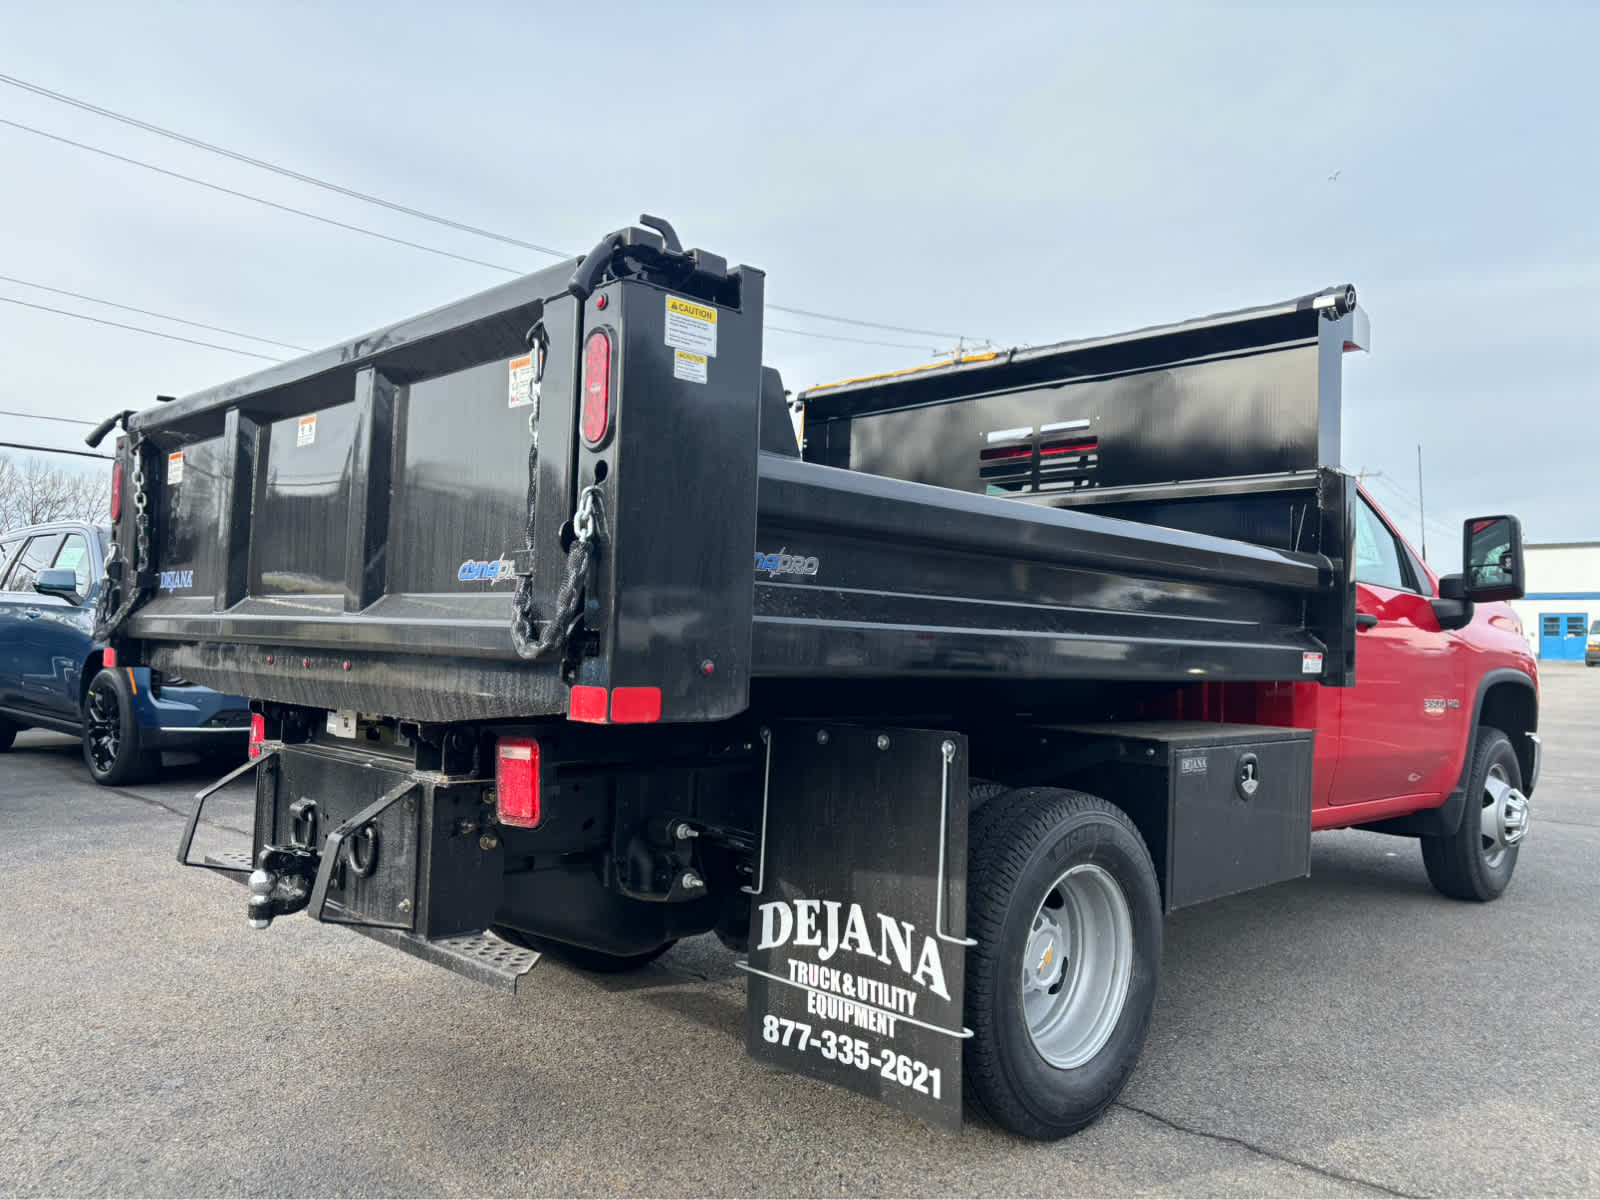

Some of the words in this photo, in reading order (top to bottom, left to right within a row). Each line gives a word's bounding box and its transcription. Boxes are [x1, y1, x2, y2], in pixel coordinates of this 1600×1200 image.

[679, 304, 712, 320] CAUTION
[757, 899, 951, 1002] DEJANA
[807, 990, 896, 1039] EQUIPMENT
[762, 1014, 942, 1100] 877-335-2621
